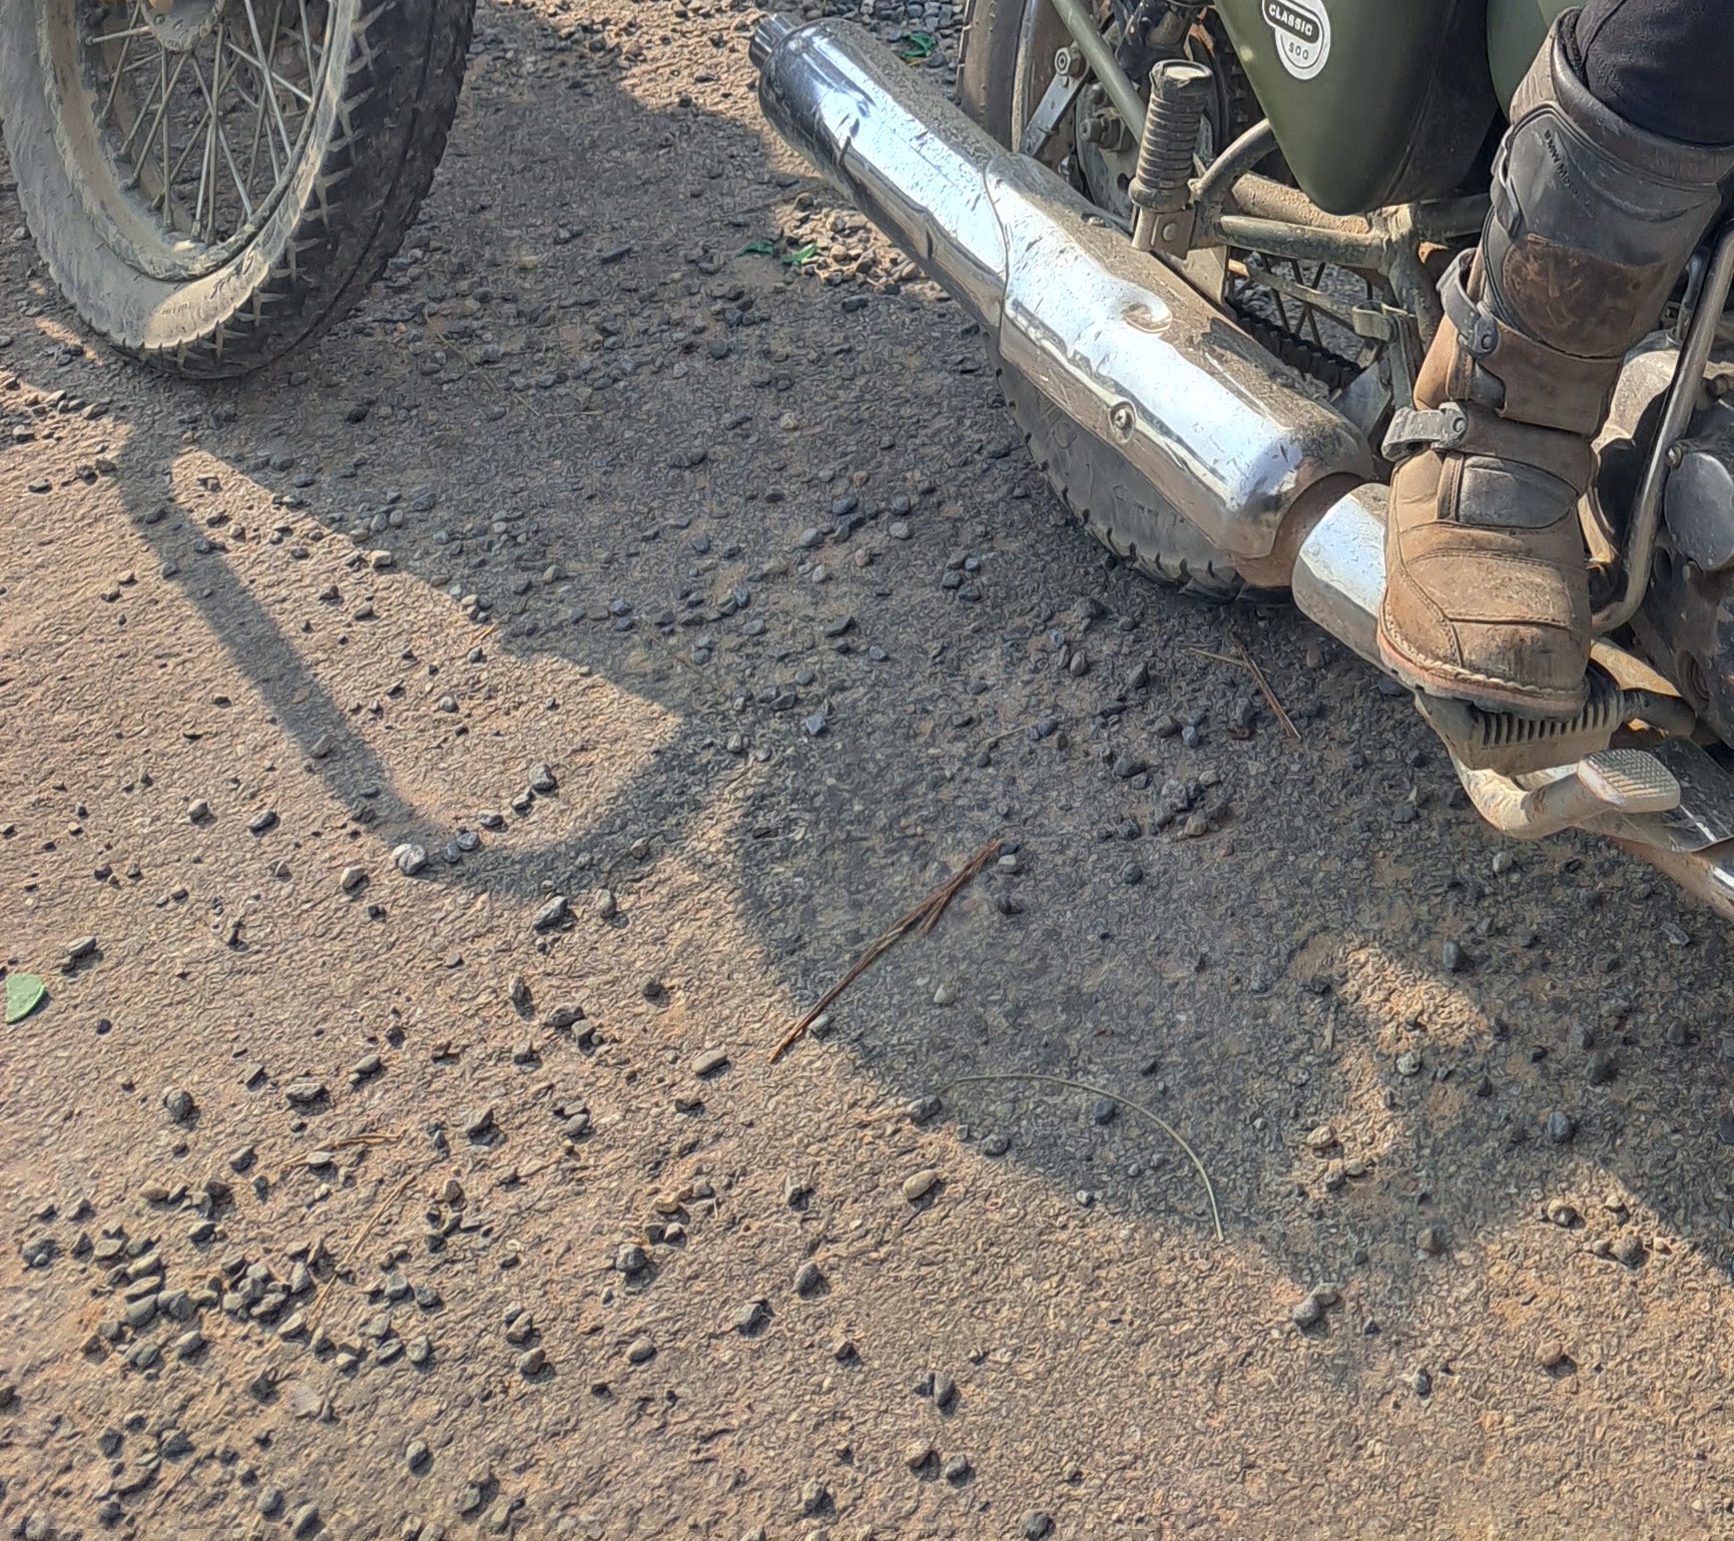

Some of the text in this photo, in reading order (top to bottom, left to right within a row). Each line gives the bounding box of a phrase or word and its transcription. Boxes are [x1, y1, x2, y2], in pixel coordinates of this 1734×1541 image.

[1268, 3, 1314, 37] CLASSIC
[1288, 41, 1310, 61] 500
[1544, 129, 1562, 165] BMW
